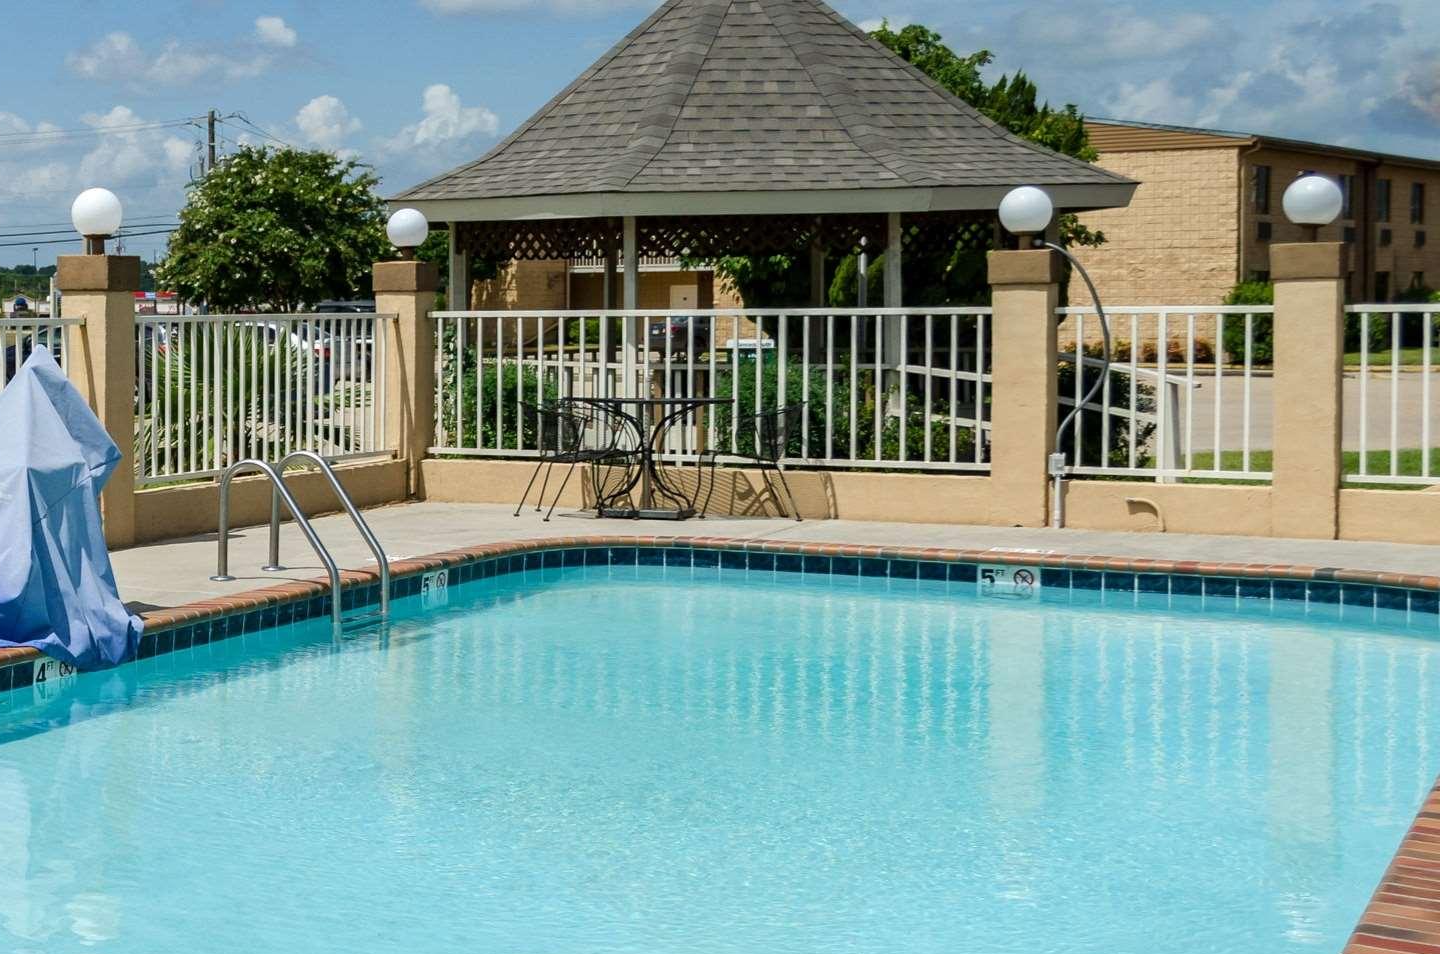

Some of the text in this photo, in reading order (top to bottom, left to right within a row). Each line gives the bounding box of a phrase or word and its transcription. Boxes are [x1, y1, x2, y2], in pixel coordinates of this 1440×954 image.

[981, 569, 995, 583] 5
[35, 661, 54, 683] 4 FT
